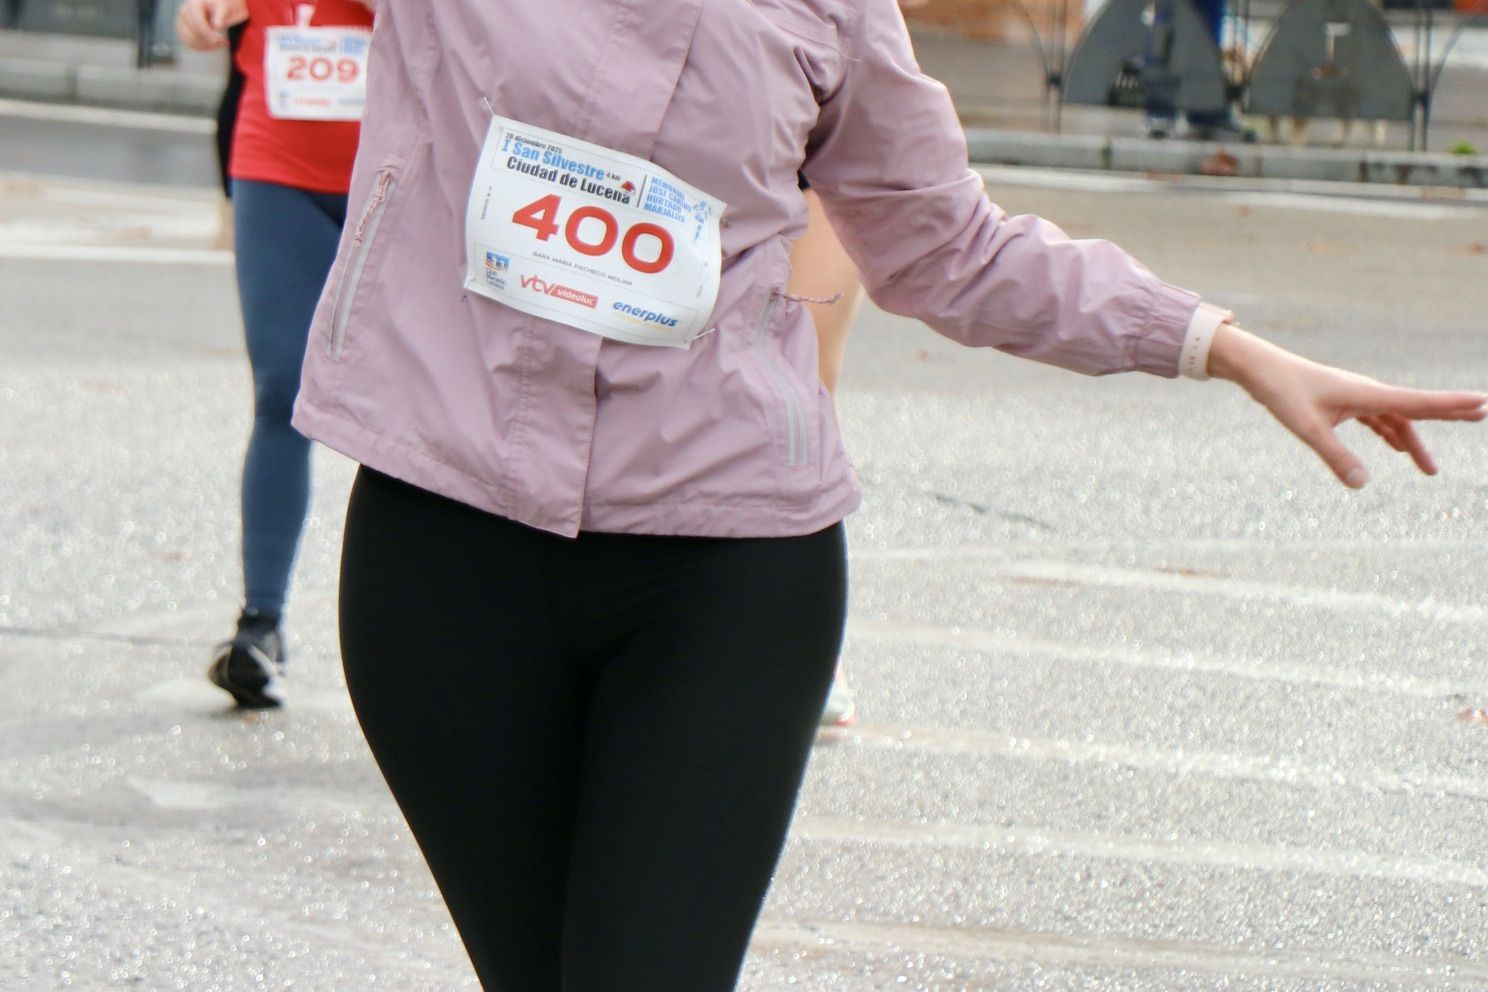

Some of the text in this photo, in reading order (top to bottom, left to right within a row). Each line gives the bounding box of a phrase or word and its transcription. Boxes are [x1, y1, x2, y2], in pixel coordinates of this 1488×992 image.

[287, 54, 360, 84] 209
[513, 142, 540, 161] San
[543, 150, 605, 180] Silvestre
[507, 156, 630, 204] Ciudad de Lucena
[647, 193, 682, 212] HURTADO
[512, 193, 675, 274] 400
[557, 288, 595, 306] videoluc
[613, 301, 678, 327] enerplus
